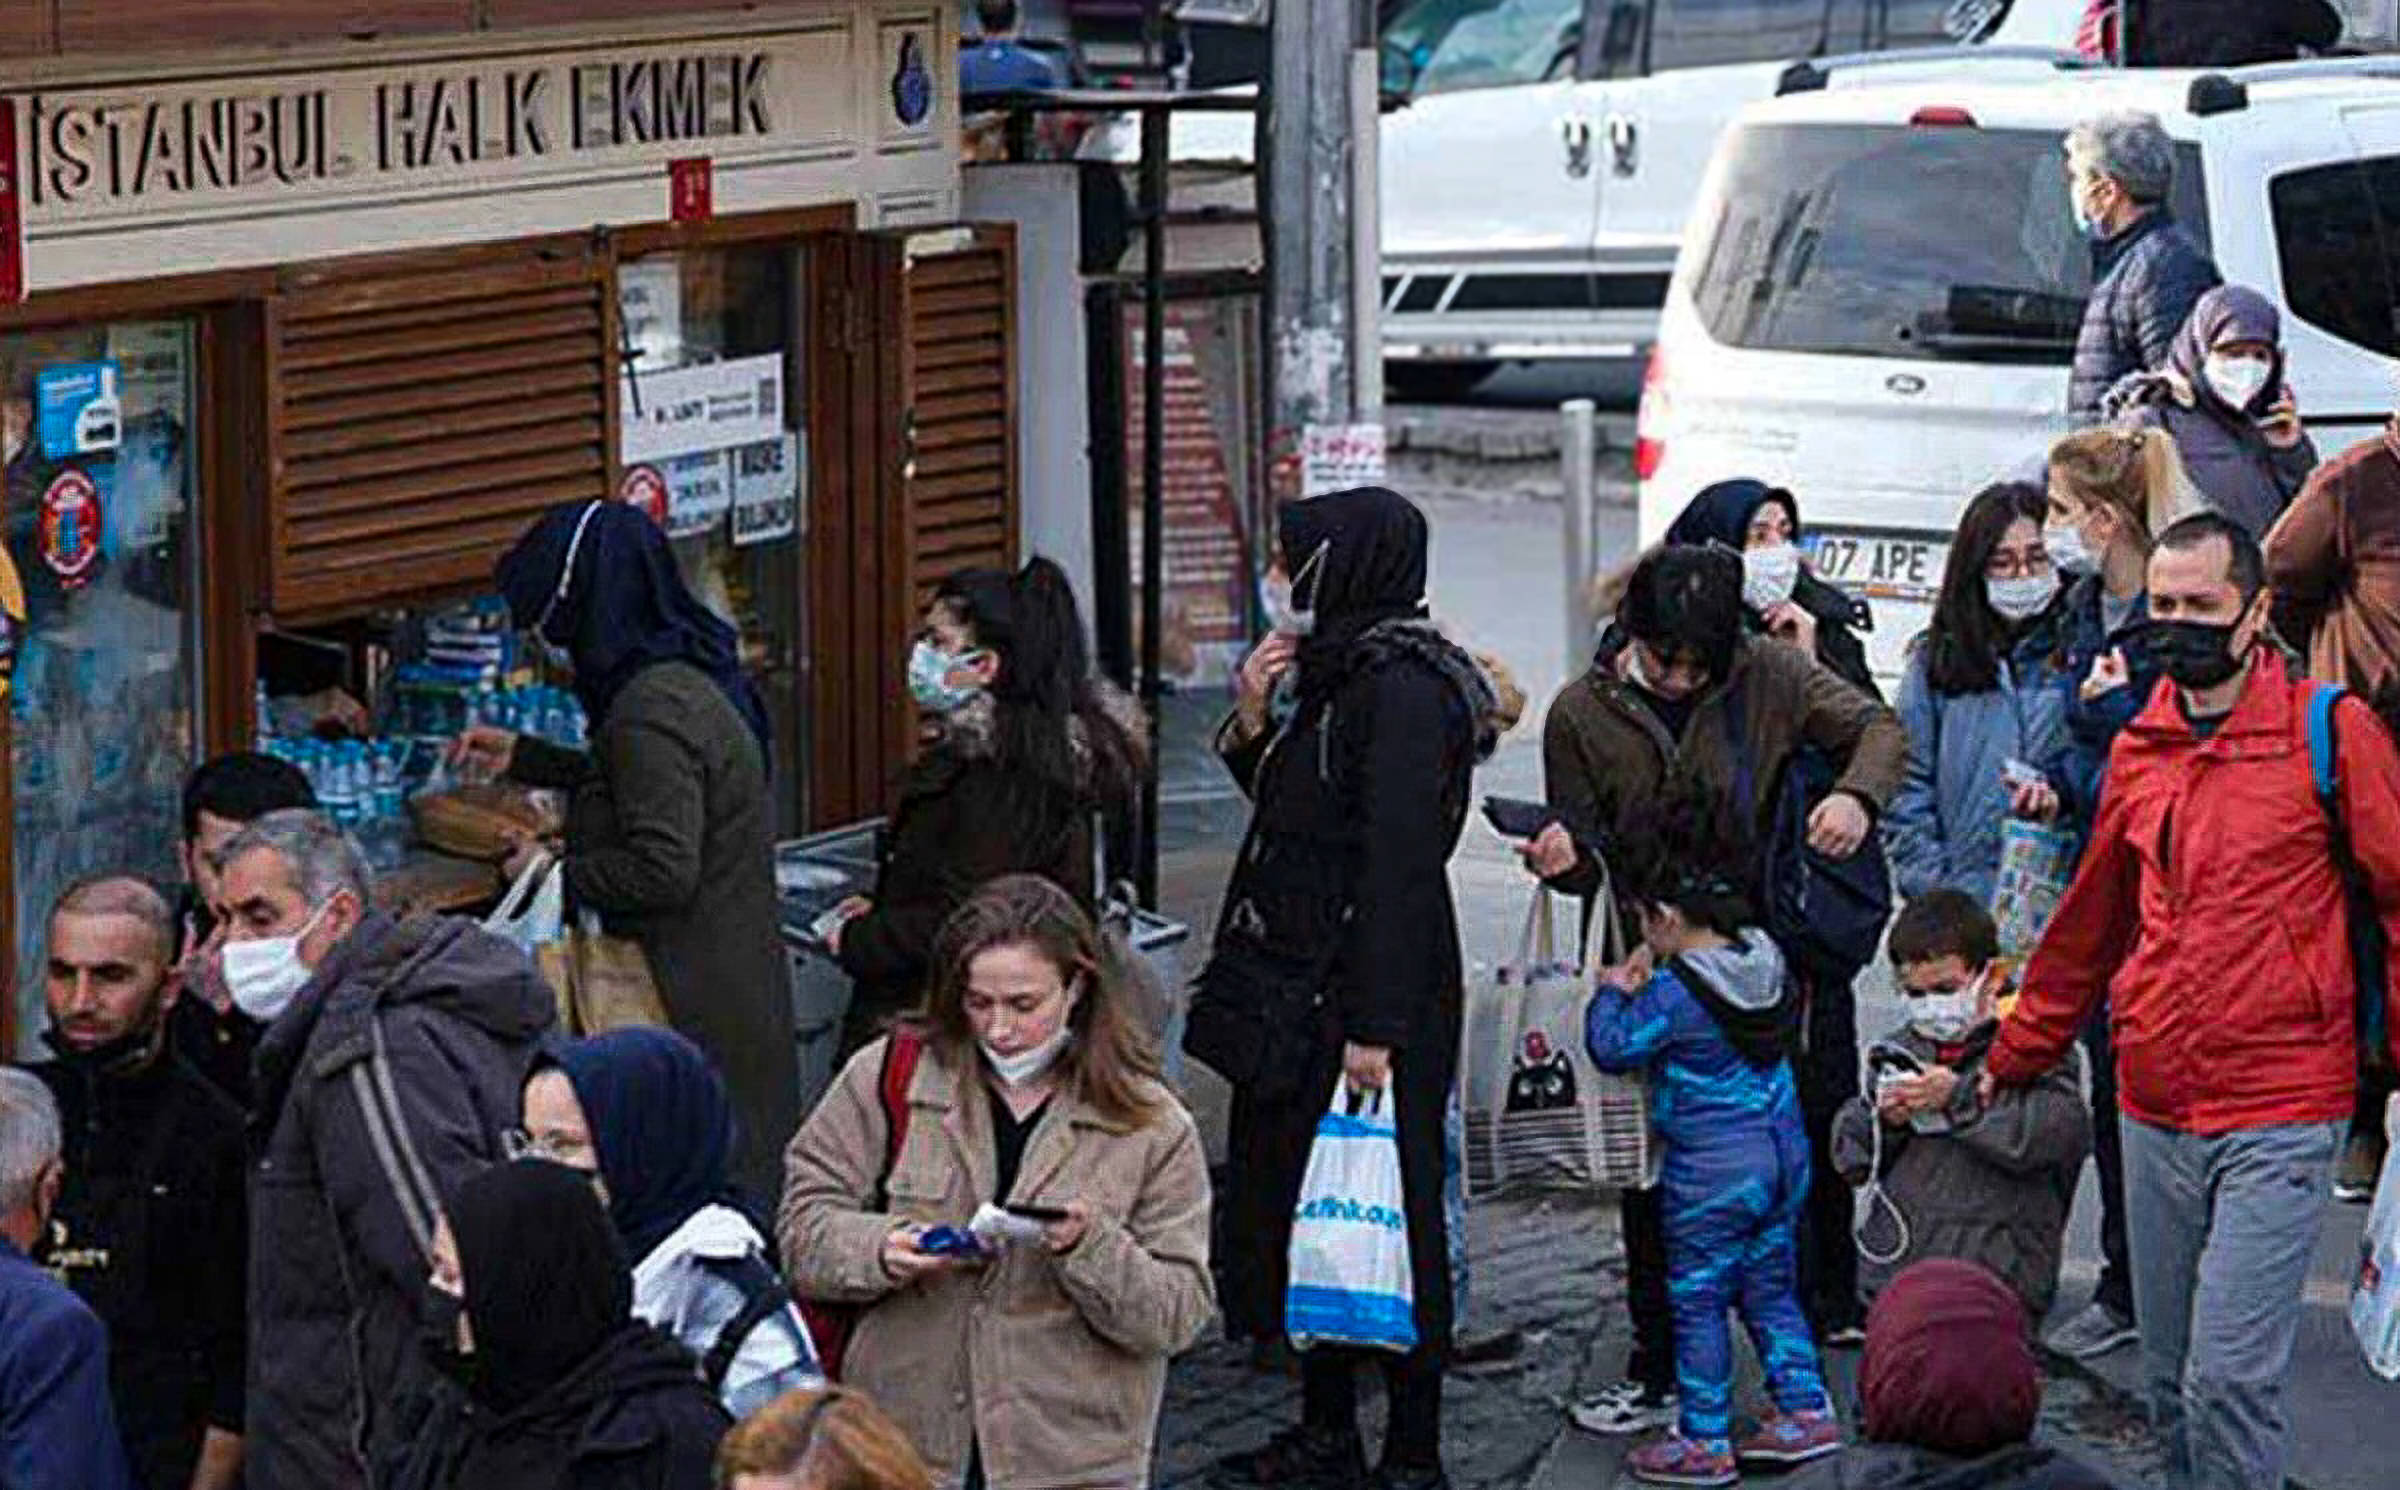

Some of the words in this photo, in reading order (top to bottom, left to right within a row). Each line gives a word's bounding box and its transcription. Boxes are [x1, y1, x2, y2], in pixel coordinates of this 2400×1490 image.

[376, 68, 549, 170] HALK
[569, 52, 769, 151] EKMEK
[1820, 539, 1859, 577] 07
[1871, 543, 1929, 583] APE
